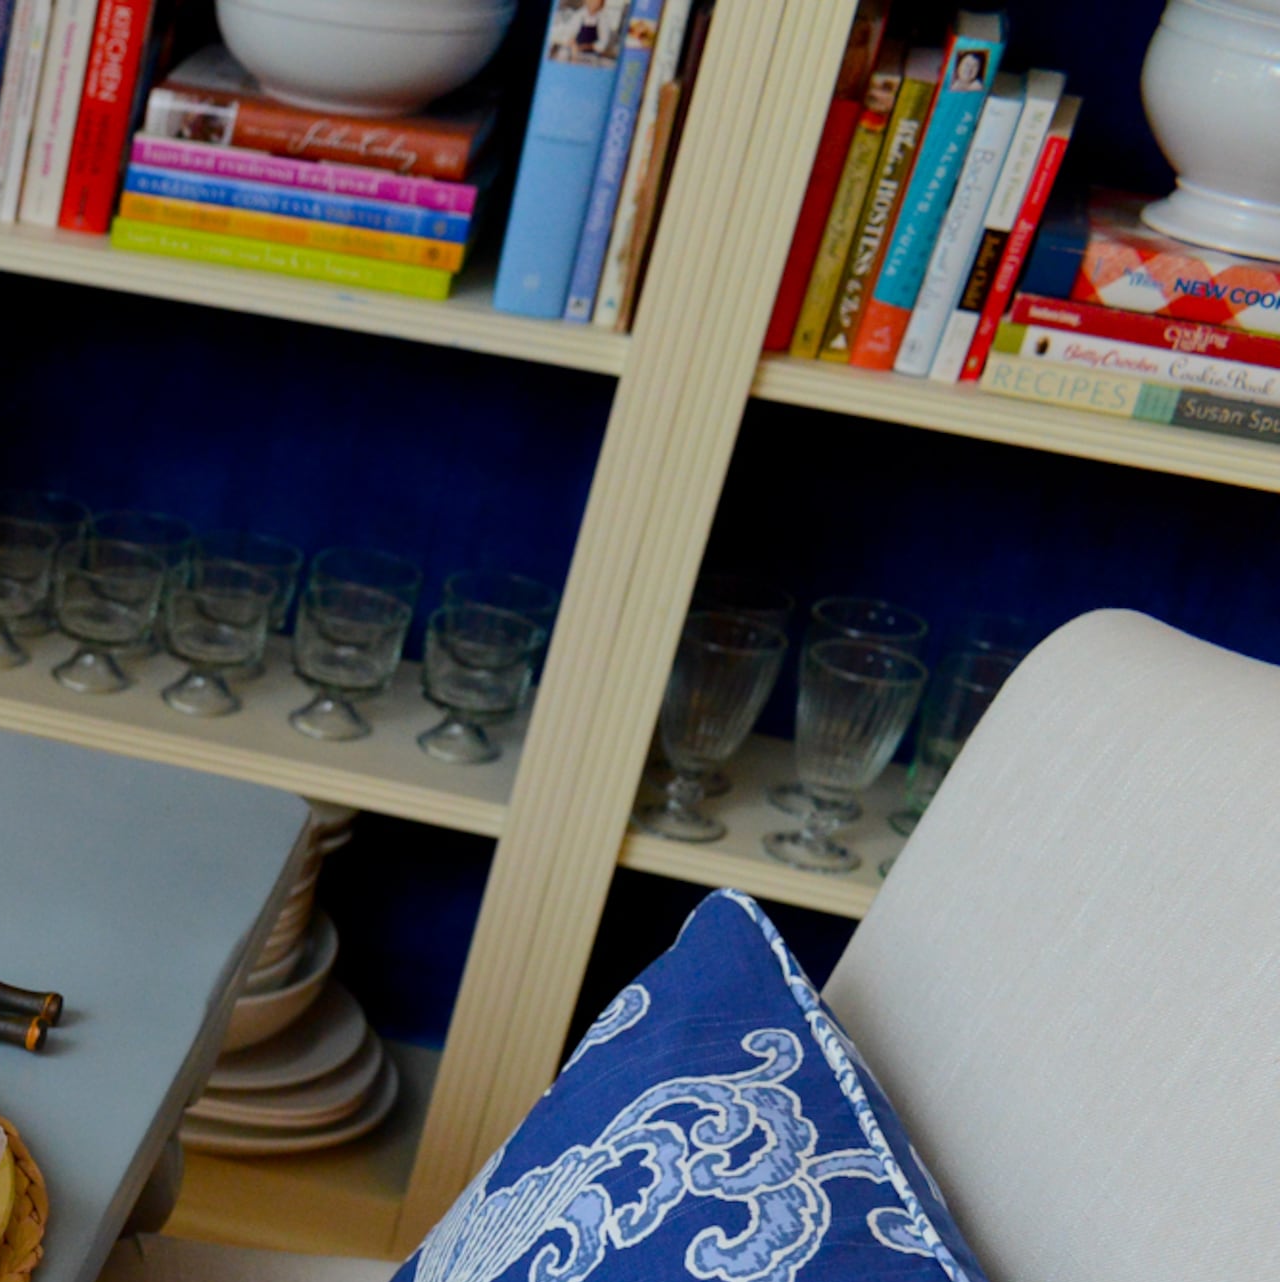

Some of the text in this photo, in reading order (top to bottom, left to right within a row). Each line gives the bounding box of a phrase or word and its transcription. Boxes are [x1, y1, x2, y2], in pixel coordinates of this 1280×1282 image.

[954, 110, 973, 136] AS
[853, 177, 899, 277] HOSTESS
[885, 222, 917, 278] JULIA
[1173, 277, 1228, 300] NEW
[991, 362, 1129, 409] RECIPES
[1183, 398, 1243, 426] Susan
